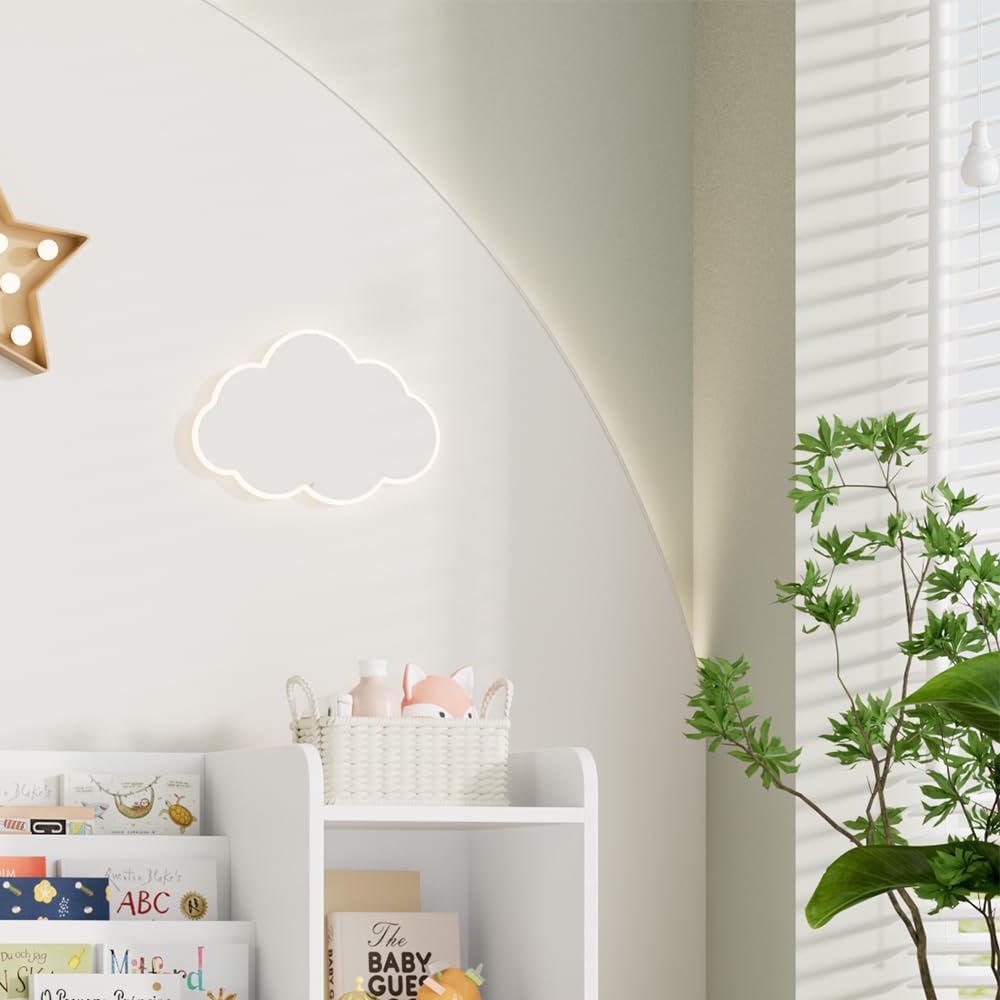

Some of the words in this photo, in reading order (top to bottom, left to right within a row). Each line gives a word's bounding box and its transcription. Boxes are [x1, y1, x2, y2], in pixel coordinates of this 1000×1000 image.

[116, 891, 170, 916] ABC
[367, 921, 408, 948] The
[1, 951, 13, 962] Du
[368, 951, 432, 973] BABY
